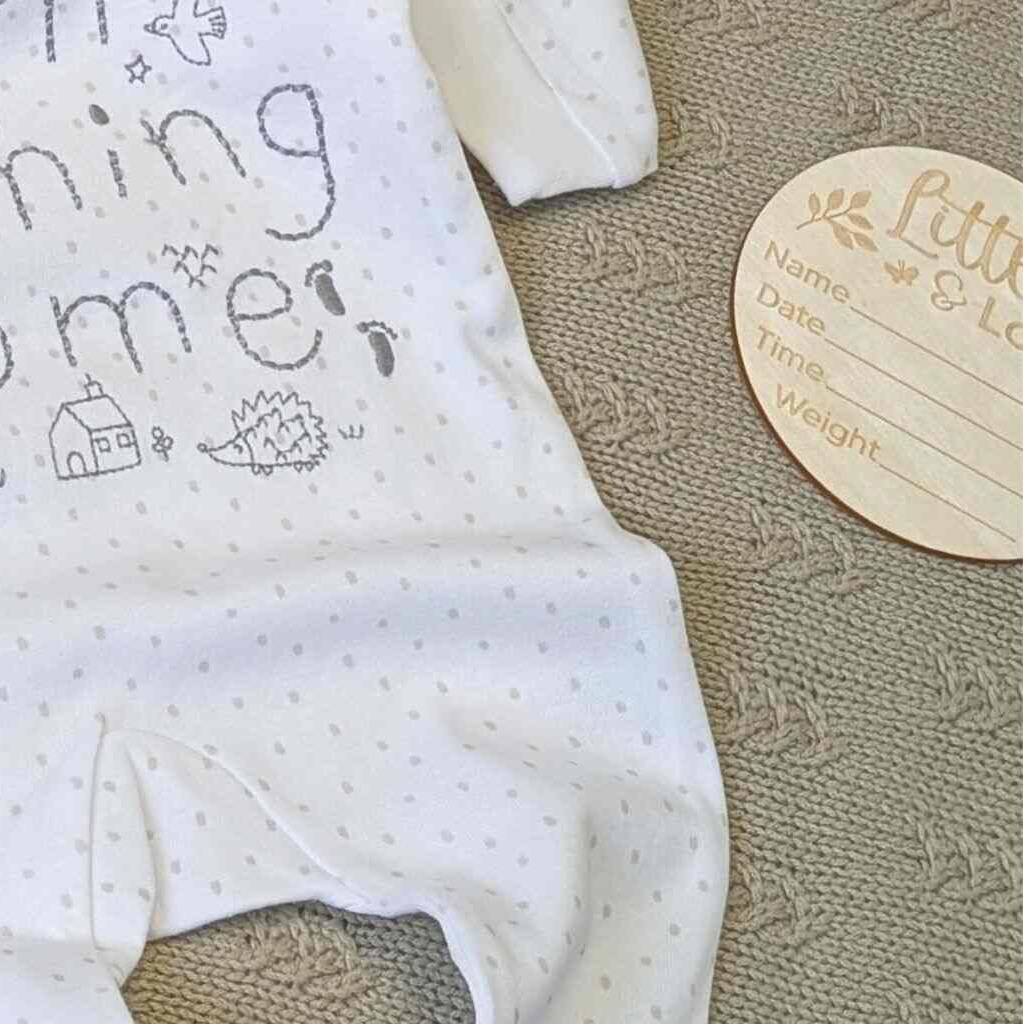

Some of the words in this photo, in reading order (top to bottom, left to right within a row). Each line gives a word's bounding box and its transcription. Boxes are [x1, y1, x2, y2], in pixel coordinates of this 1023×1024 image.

[763, 240, 850, 305] Name
[930, 270, 967, 311] &
[756, 282, 825, 336] Date
[753, 325, 825, 384] Time
[775, 384, 882, 463] Weight
